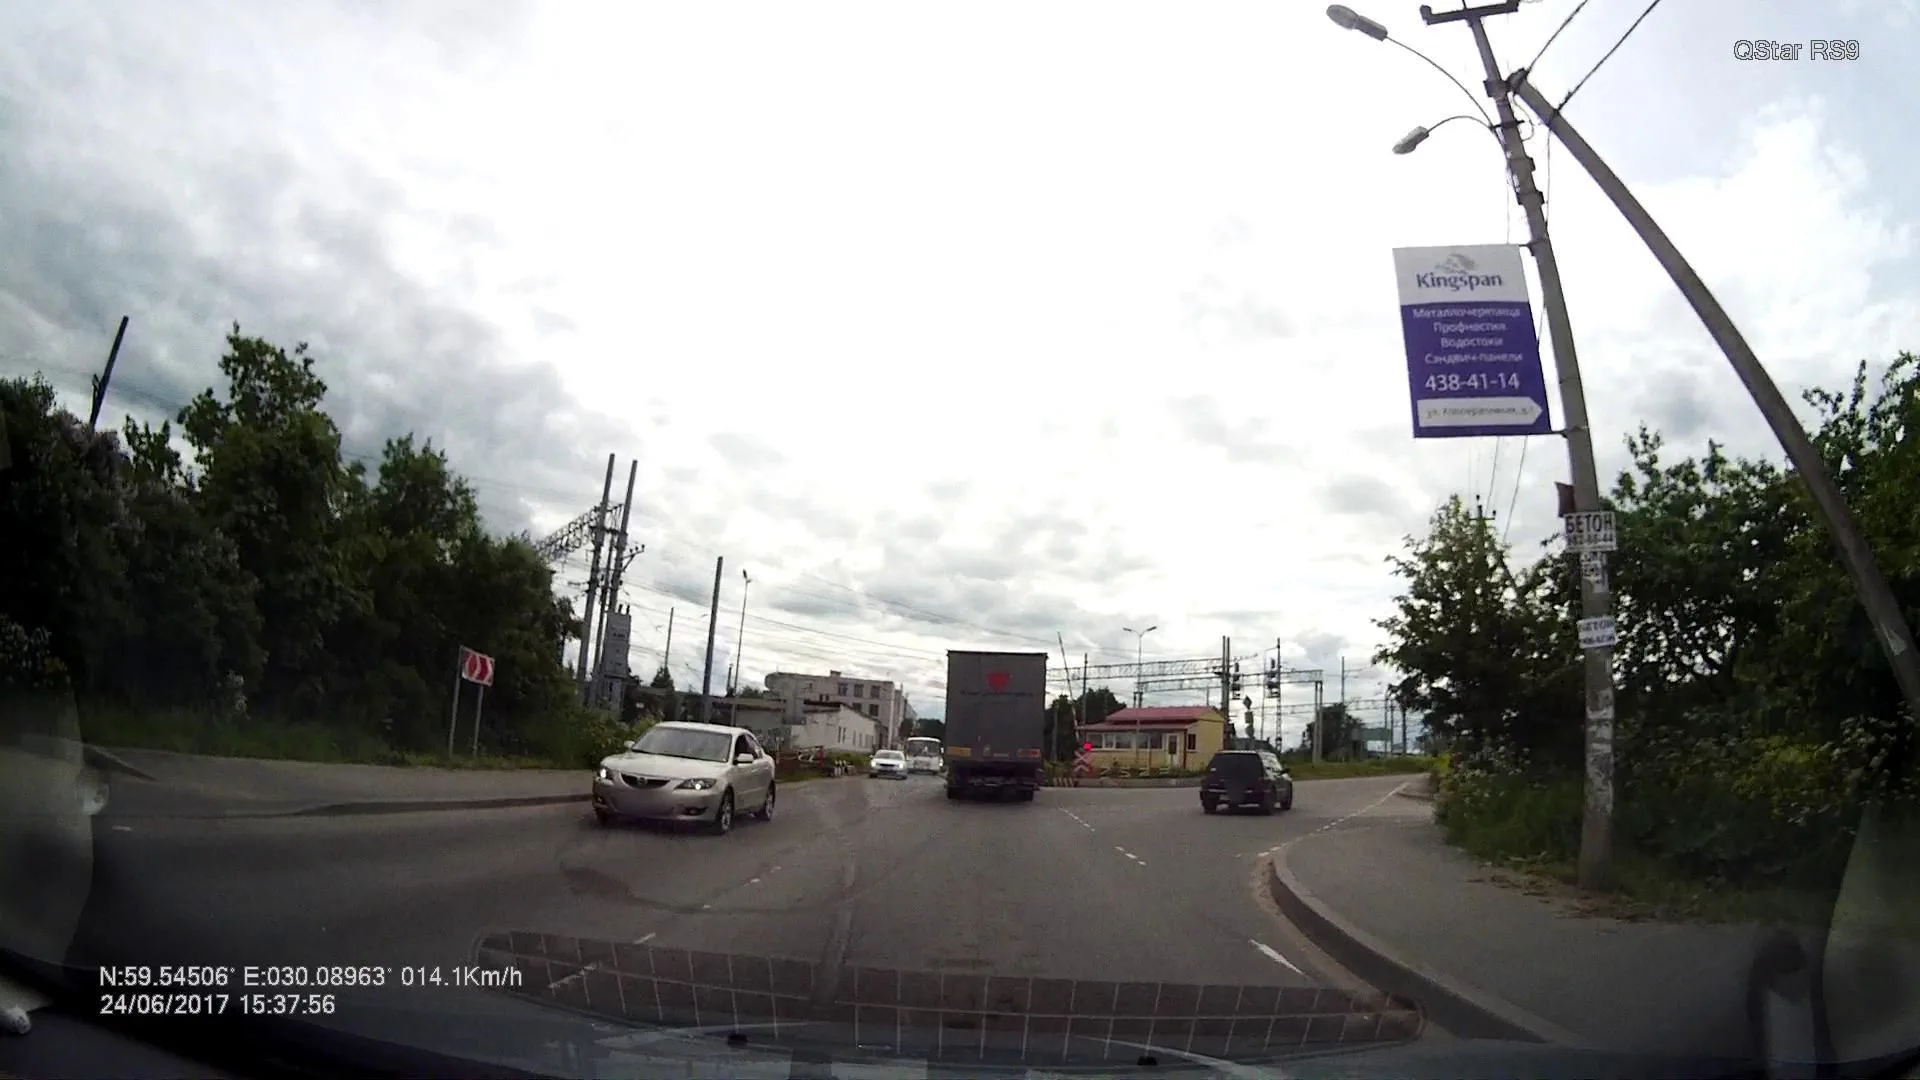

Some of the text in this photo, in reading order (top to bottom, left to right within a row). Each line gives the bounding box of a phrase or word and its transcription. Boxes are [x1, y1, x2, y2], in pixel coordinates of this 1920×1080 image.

[1416, 272, 1503, 291] Kingspan
[1440, 337, 1504, 350] Водостоки
[1425, 372, 1520, 391] 438-41-14
[1565, 512, 1613, 534] БЕТОН
